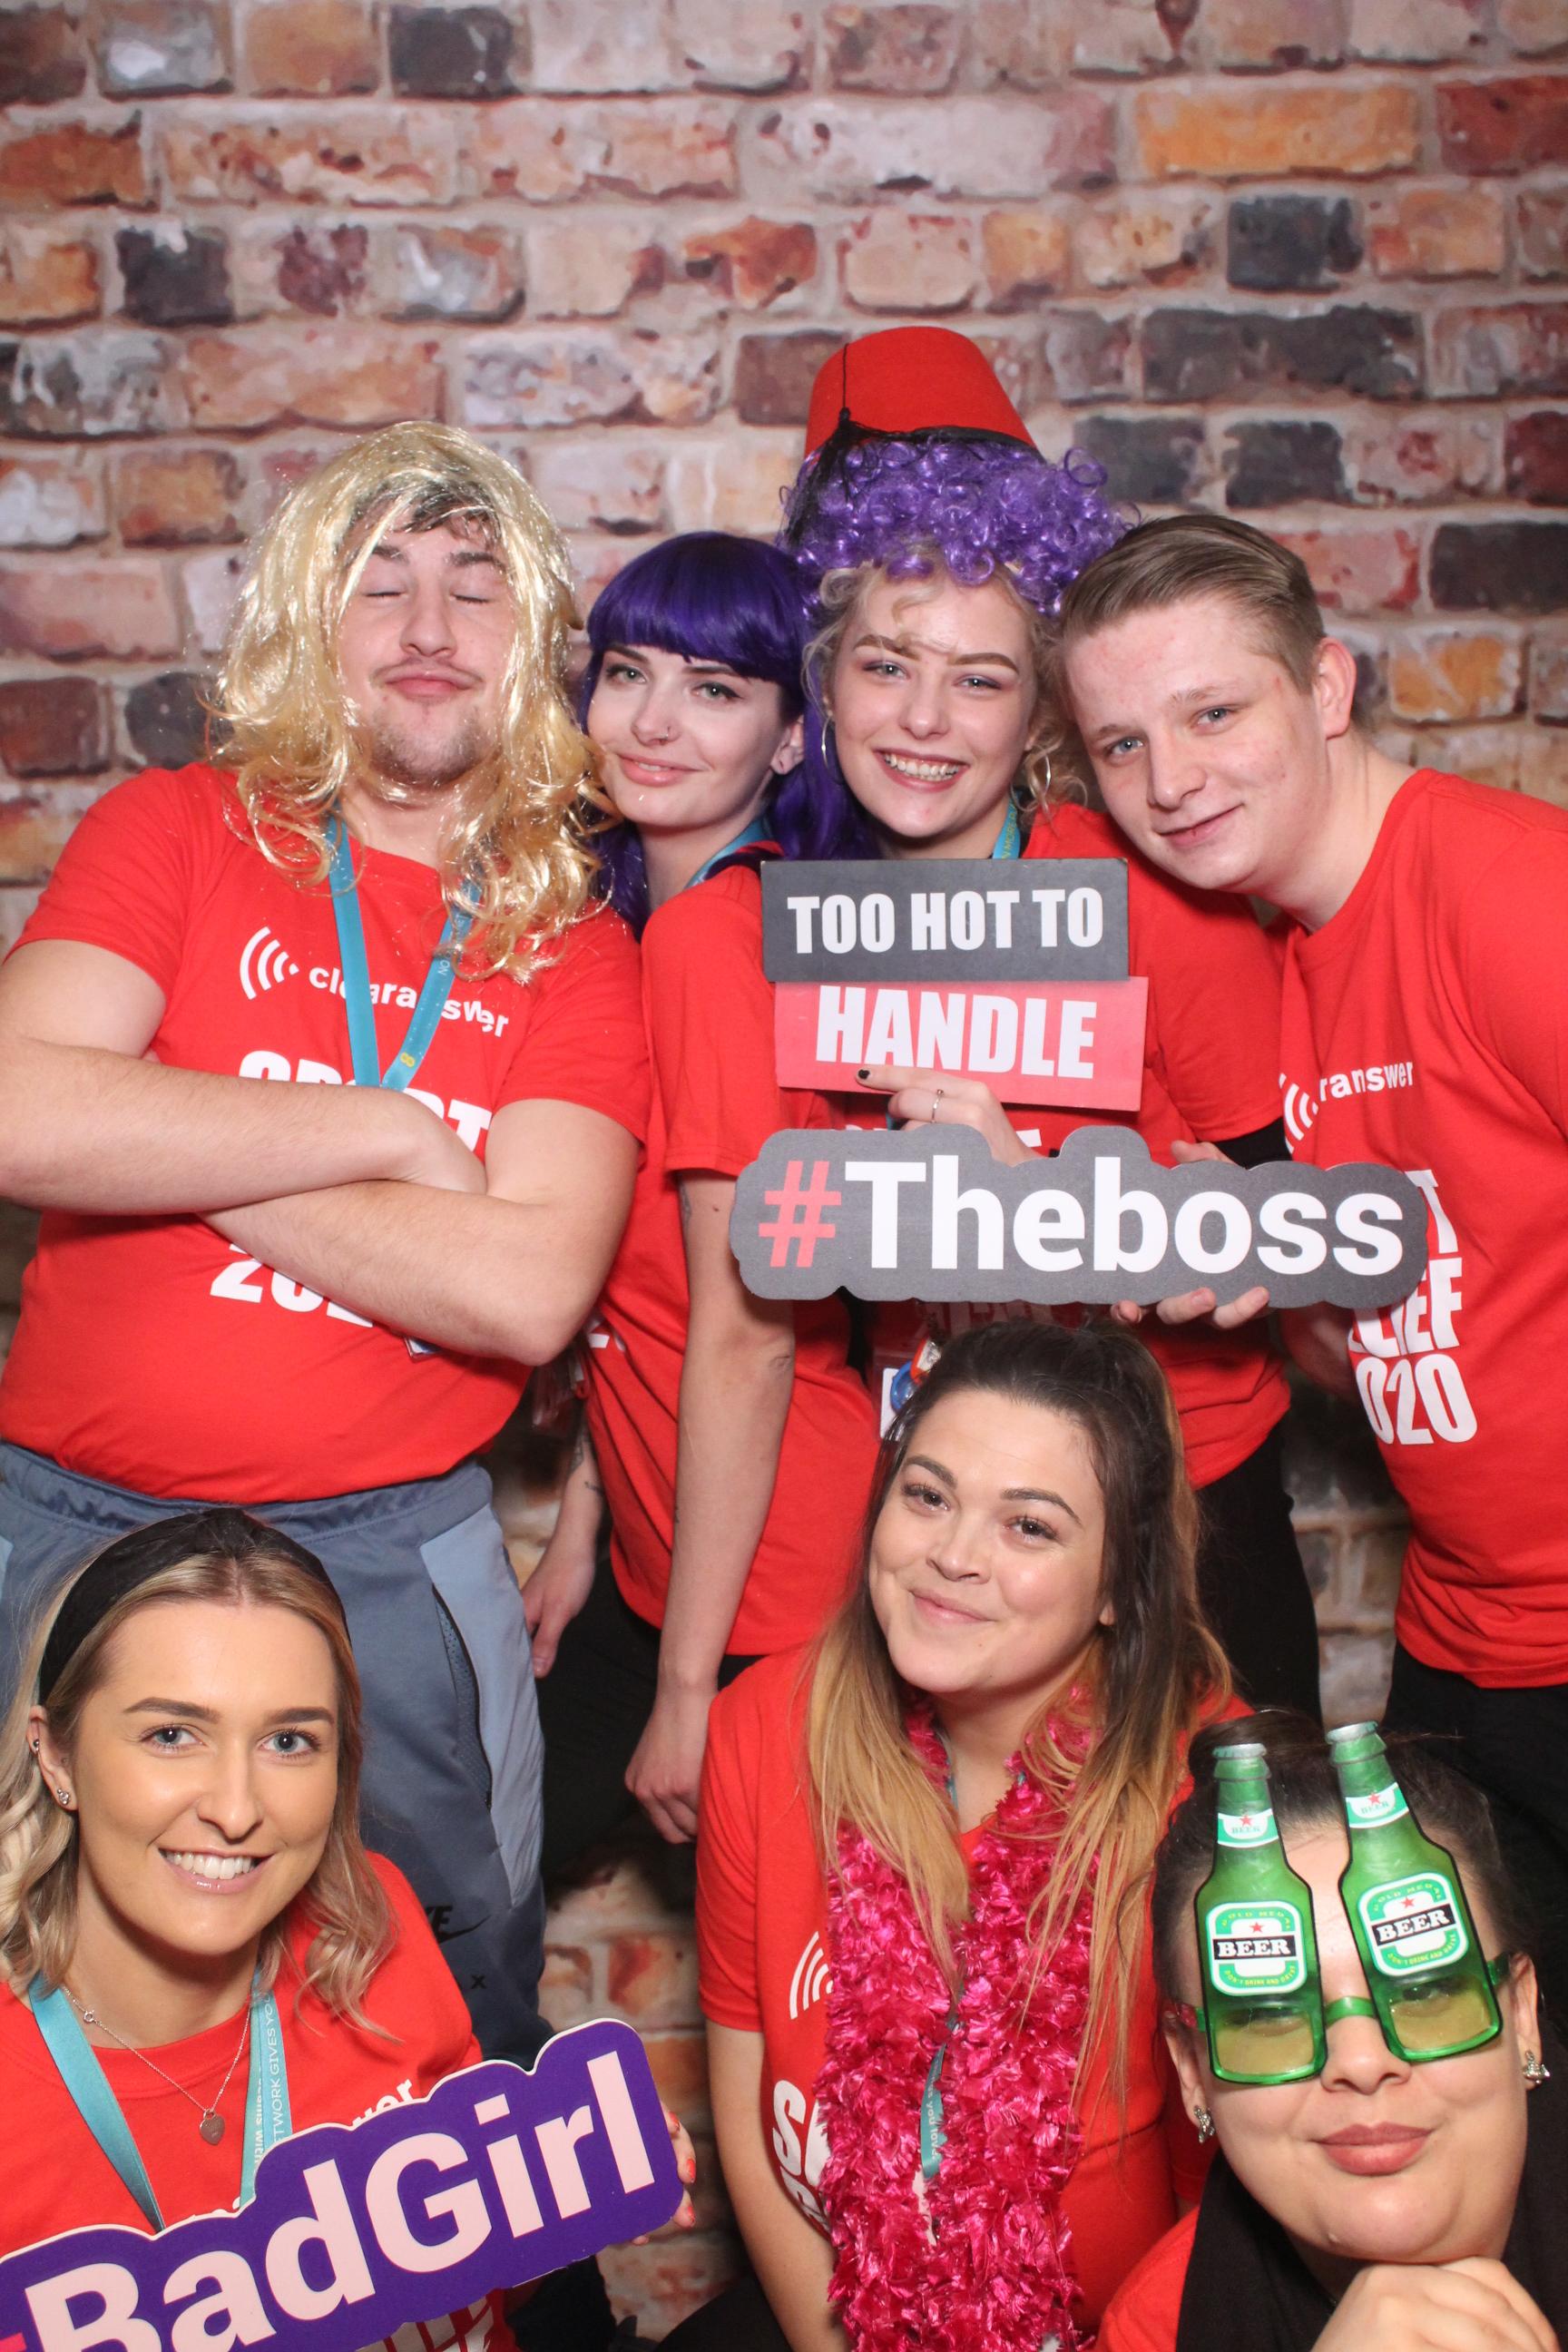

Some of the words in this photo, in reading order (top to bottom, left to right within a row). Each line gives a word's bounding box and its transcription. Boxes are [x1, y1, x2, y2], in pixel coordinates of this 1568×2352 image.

[787, 893, 896, 954] TOO
[910, 890, 1020, 951] HOT
[1032, 887, 1103, 948] TO
[309, 966, 508, 1037] claraswer
[816, 985, 1098, 1079] HANDLE
[1318, 1062, 1414, 1102] ranswer
[758, 1154, 1405, 1276] #Theboss
[1356, 1353, 1477, 1446] 020
[1217, 1938, 1291, 1958] BEER
[1376, 1908, 1450, 1943] BEER
[267, 2027, 280, 2075] GIVES
[0, 2050, 656, 2352] BadGirl
